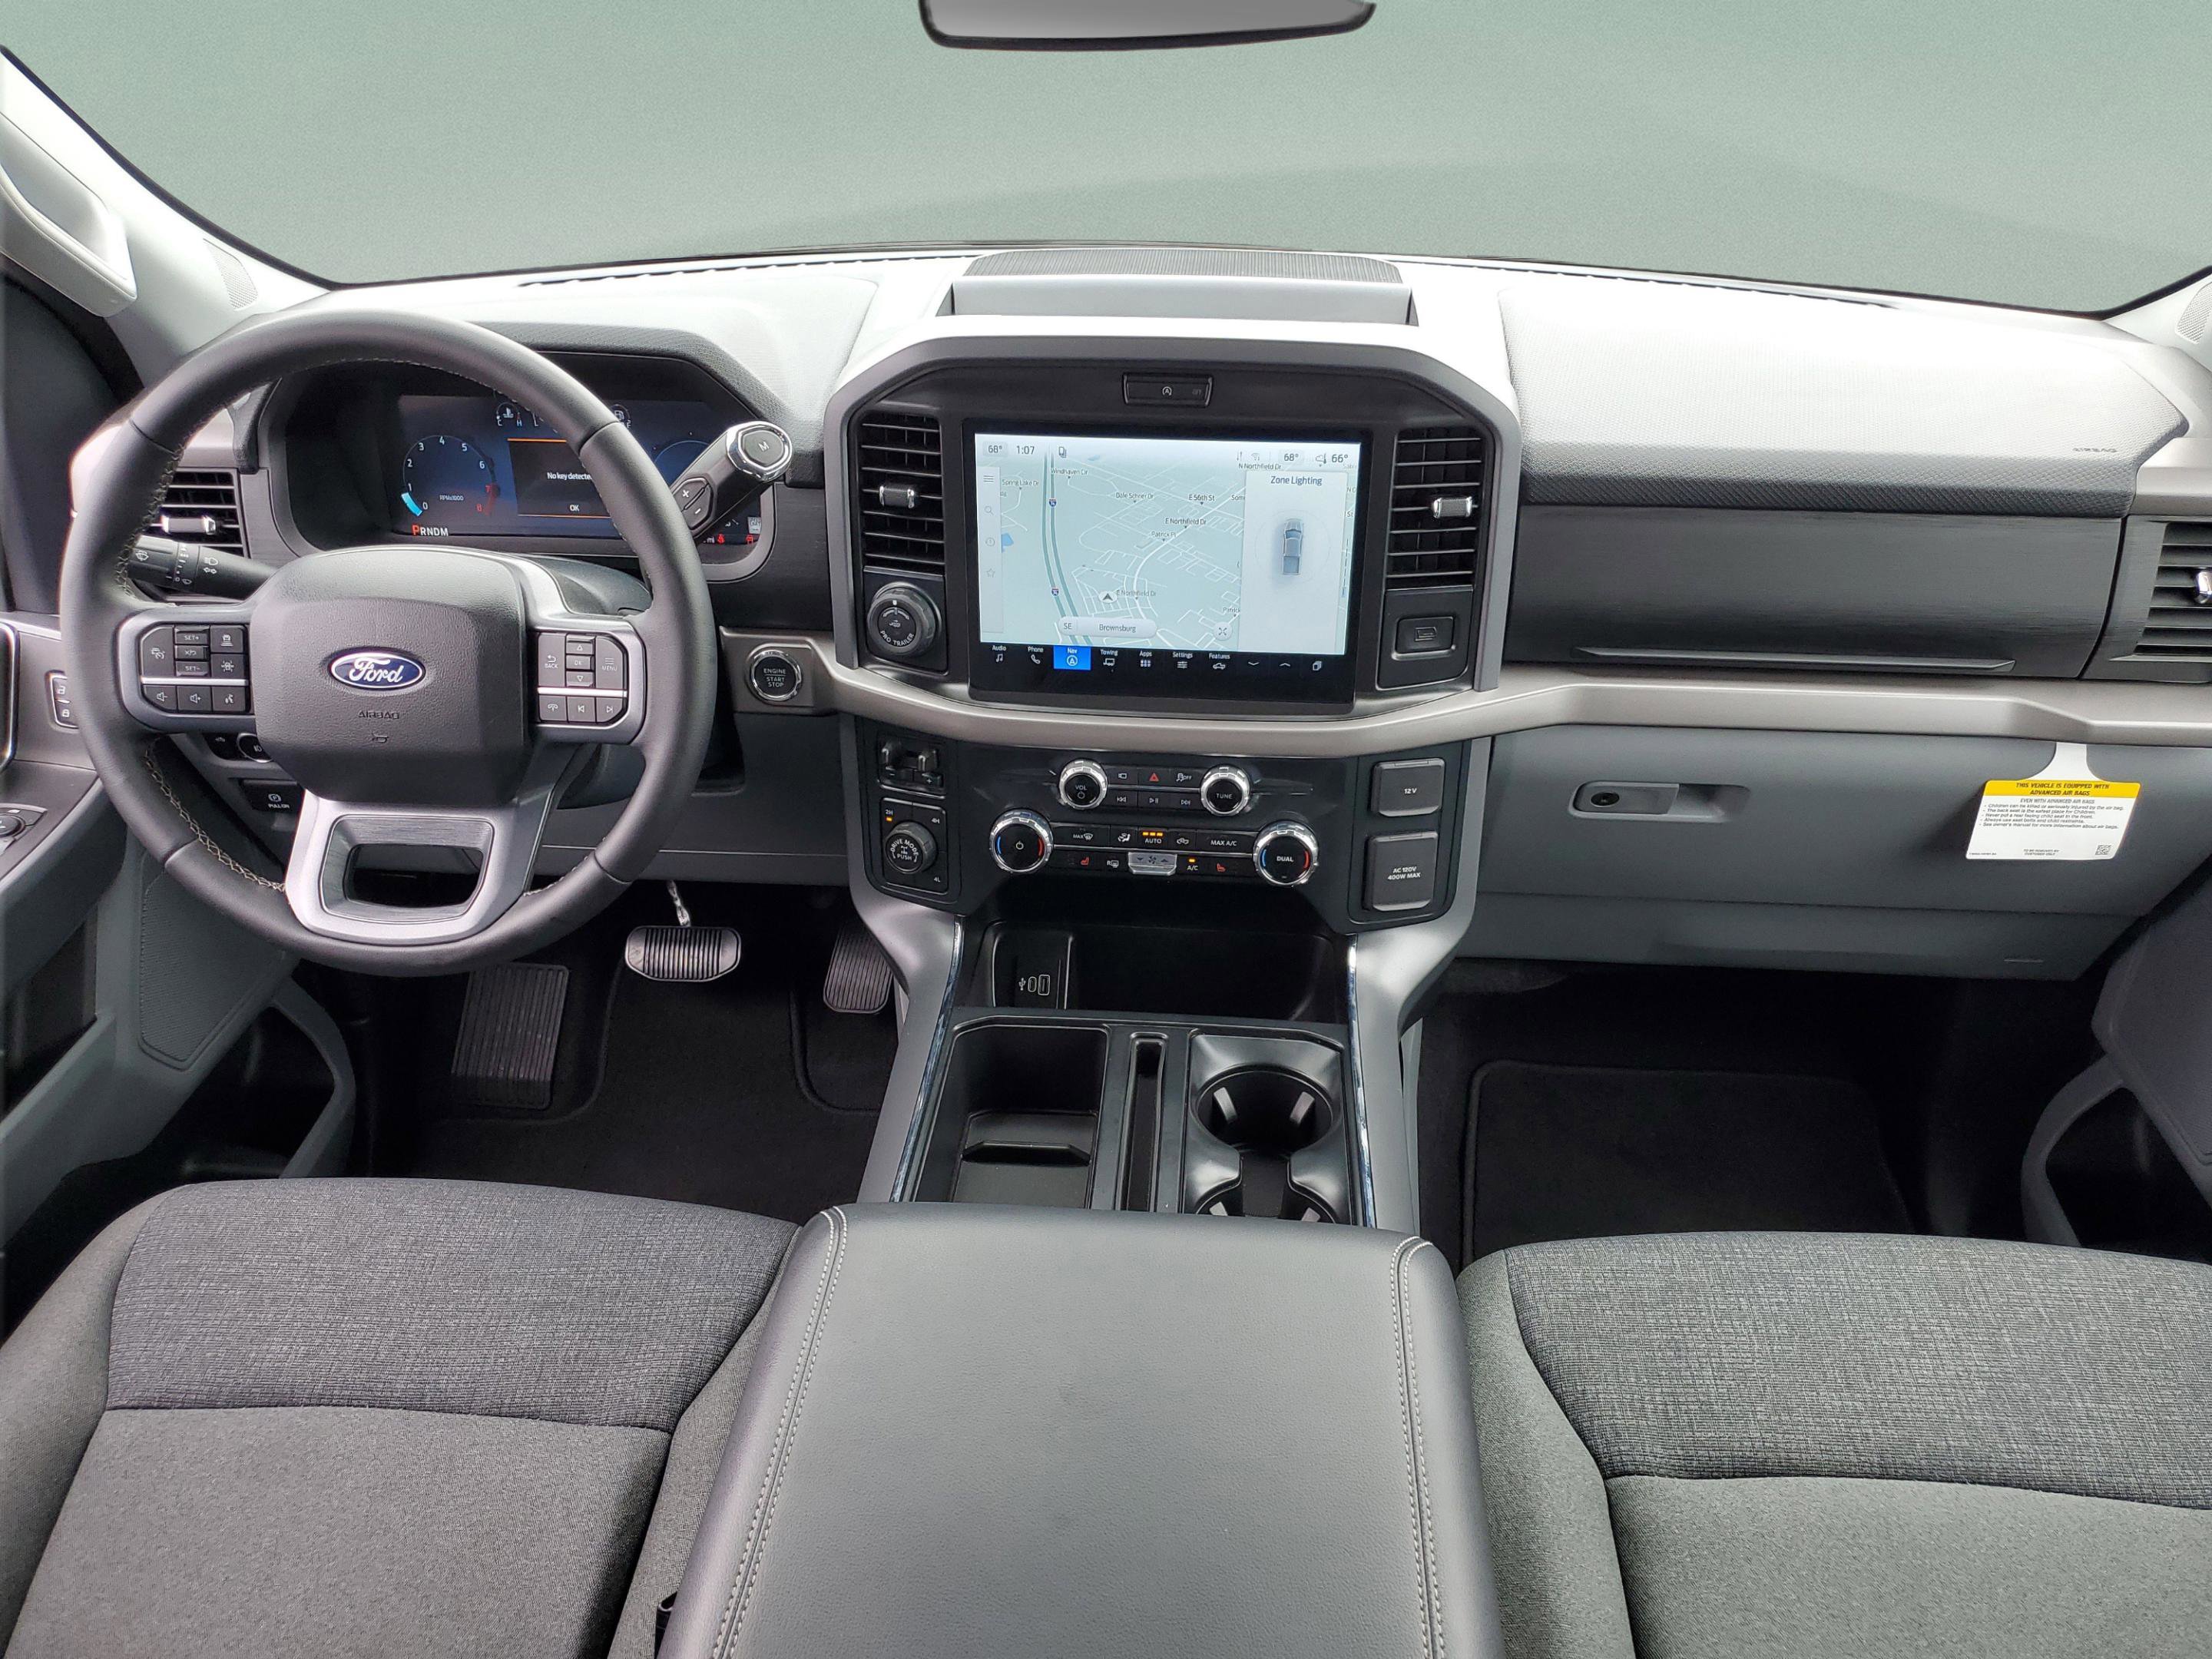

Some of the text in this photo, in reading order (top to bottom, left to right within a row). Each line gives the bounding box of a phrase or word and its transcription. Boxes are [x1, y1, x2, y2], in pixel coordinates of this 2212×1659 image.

[439, 435, 445, 445] 4
[418, 442, 424, 451] 3
[462, 443, 468, 452] 5
[758, 441, 770, 452] M
[1016, 445, 1035, 455] 1:07
[407, 459, 413, 467] 2
[479, 461, 485, 469] 6
[556, 472, 567, 480] key
[1270, 475, 1323, 485] Zone Lighting
[408, 483, 412, 492] 1
[422, 502, 428, 510] 0
[570, 504, 580, 512] OK
[1099, 624, 1136, 633] Brownsburg
[880, 630, 915, 647] PRO TRAILER
[349, 657, 404, 683] Ford
[358, 710, 399, 720] AIRBAG
[889, 838, 919, 856] DRIVE MODE
[896, 853, 912, 861] PUSH
